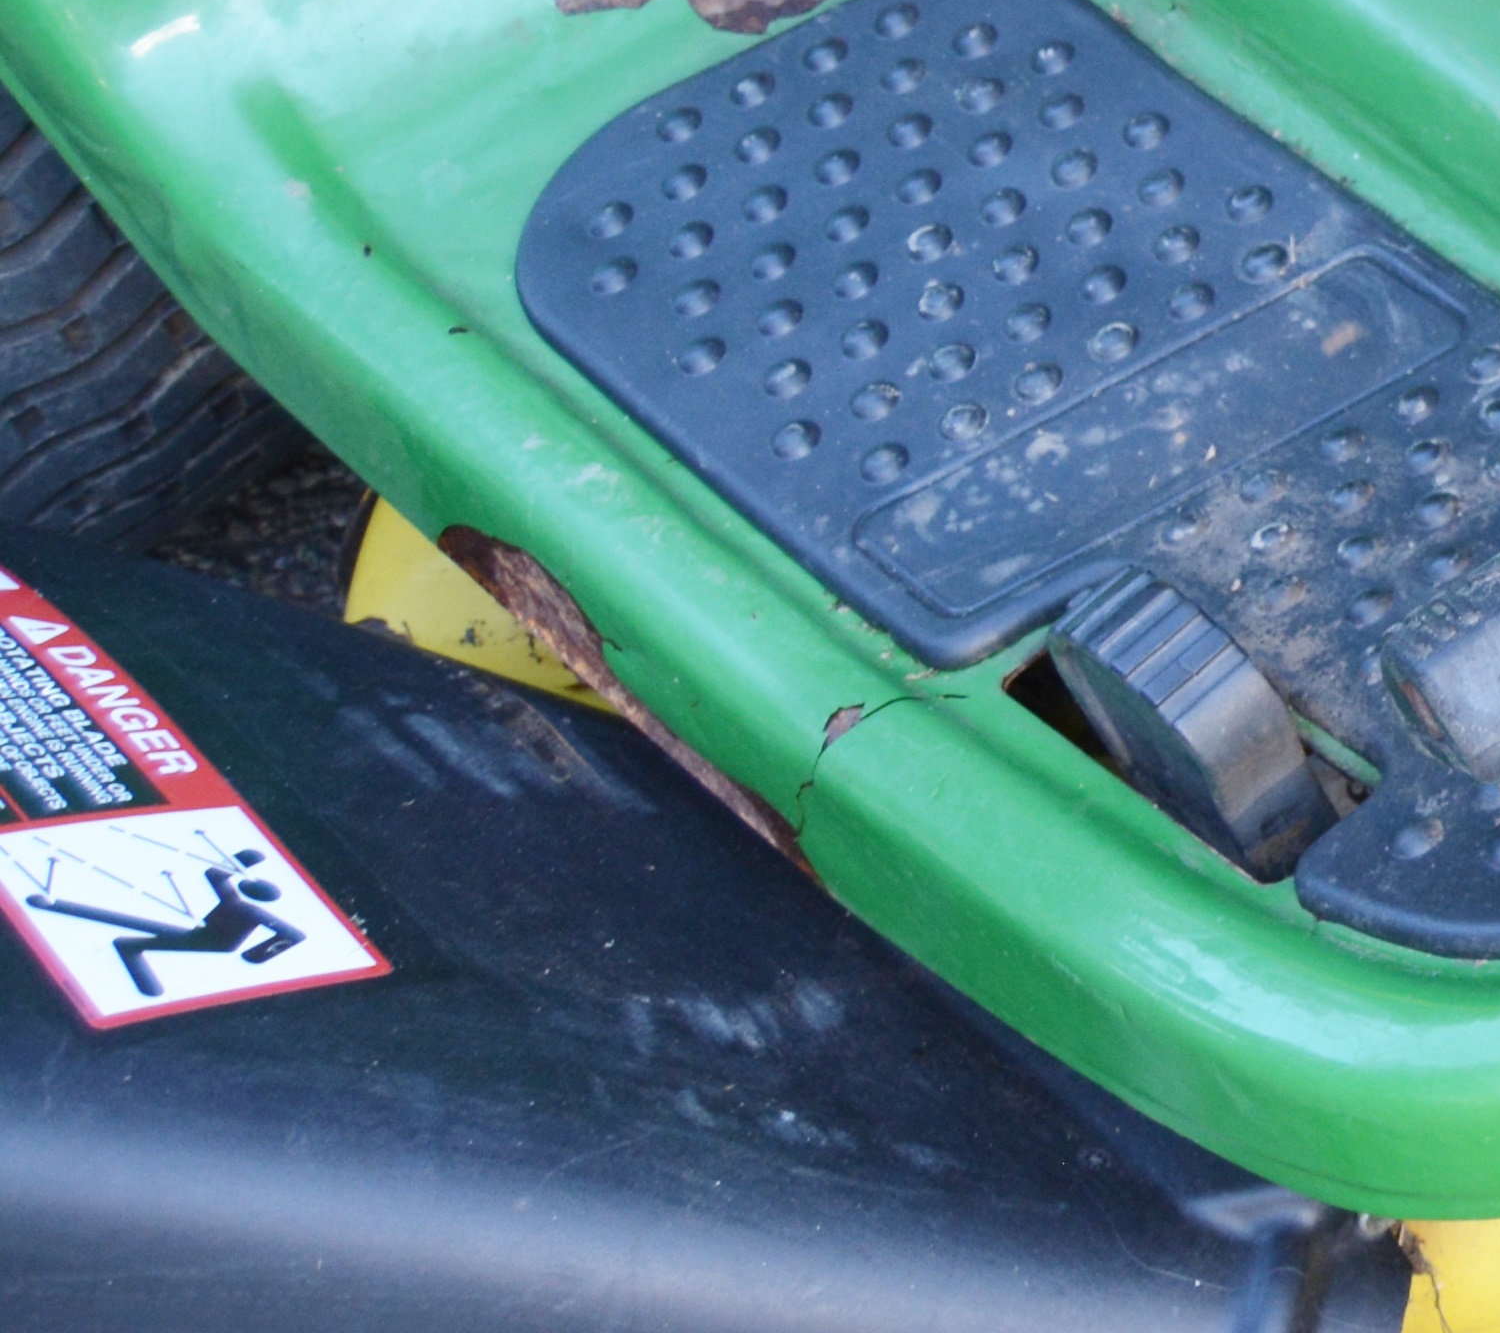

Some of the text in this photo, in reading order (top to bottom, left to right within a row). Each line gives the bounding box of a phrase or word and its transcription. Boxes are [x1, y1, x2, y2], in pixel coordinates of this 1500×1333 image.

[0, 703, 65, 779] BJECTS
[6, 698, 54, 739] ENGINE
[45, 738, 67, 753] IS
[56, 751, 112, 804] RUNNING
[27, 697, 52, 714] OR
[43, 713, 80, 742] FEET
[71, 742, 115, 783] UNDER
[107, 783, 133, 802] OR
[47, 644, 198, 775] DANGER
[61, 707, 128, 767] BLADE
[13, 760, 67, 810] OBJECTS
